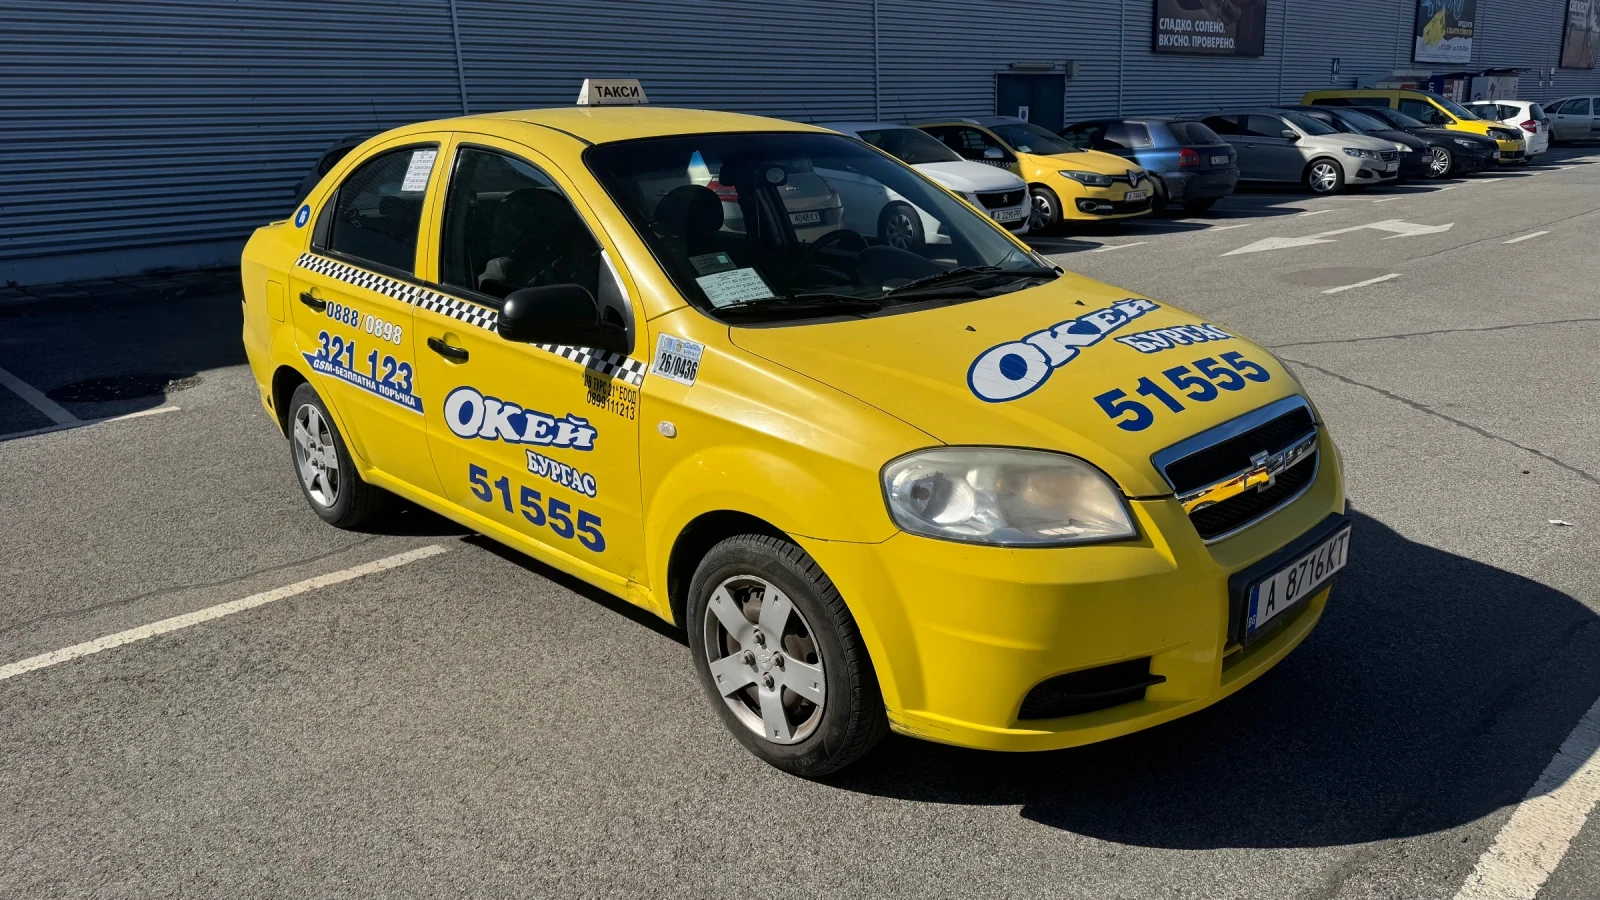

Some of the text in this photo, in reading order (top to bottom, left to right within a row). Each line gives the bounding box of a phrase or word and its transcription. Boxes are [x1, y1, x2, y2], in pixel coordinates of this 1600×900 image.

[1158, 33, 1236, 49] ВКУСНО. ПРОВЕРЕНО.
[1159, 17, 1225, 34] СЛАДКО. СОЛЕНО.
[594, 86, 640, 98] ТАКСИ
[966, 297, 1162, 404] ОКЕЙ
[1113, 322, 1237, 354] БУРГАС
[318, 331, 413, 395] 321 123
[658, 352, 698, 381] 26/0436
[379, 383, 416, 407] ПОРЪЧКА
[586, 390, 635, 421] 0899111213
[619, 386, 637, 408] ЕООД
[1093, 351, 1271, 432] 51555
[443, 386, 598, 451] ОКЕЙ
[525, 449, 597, 498] БУРГАС
[468, 462, 606, 553] 51555
[1265, 579, 1276, 617] A
